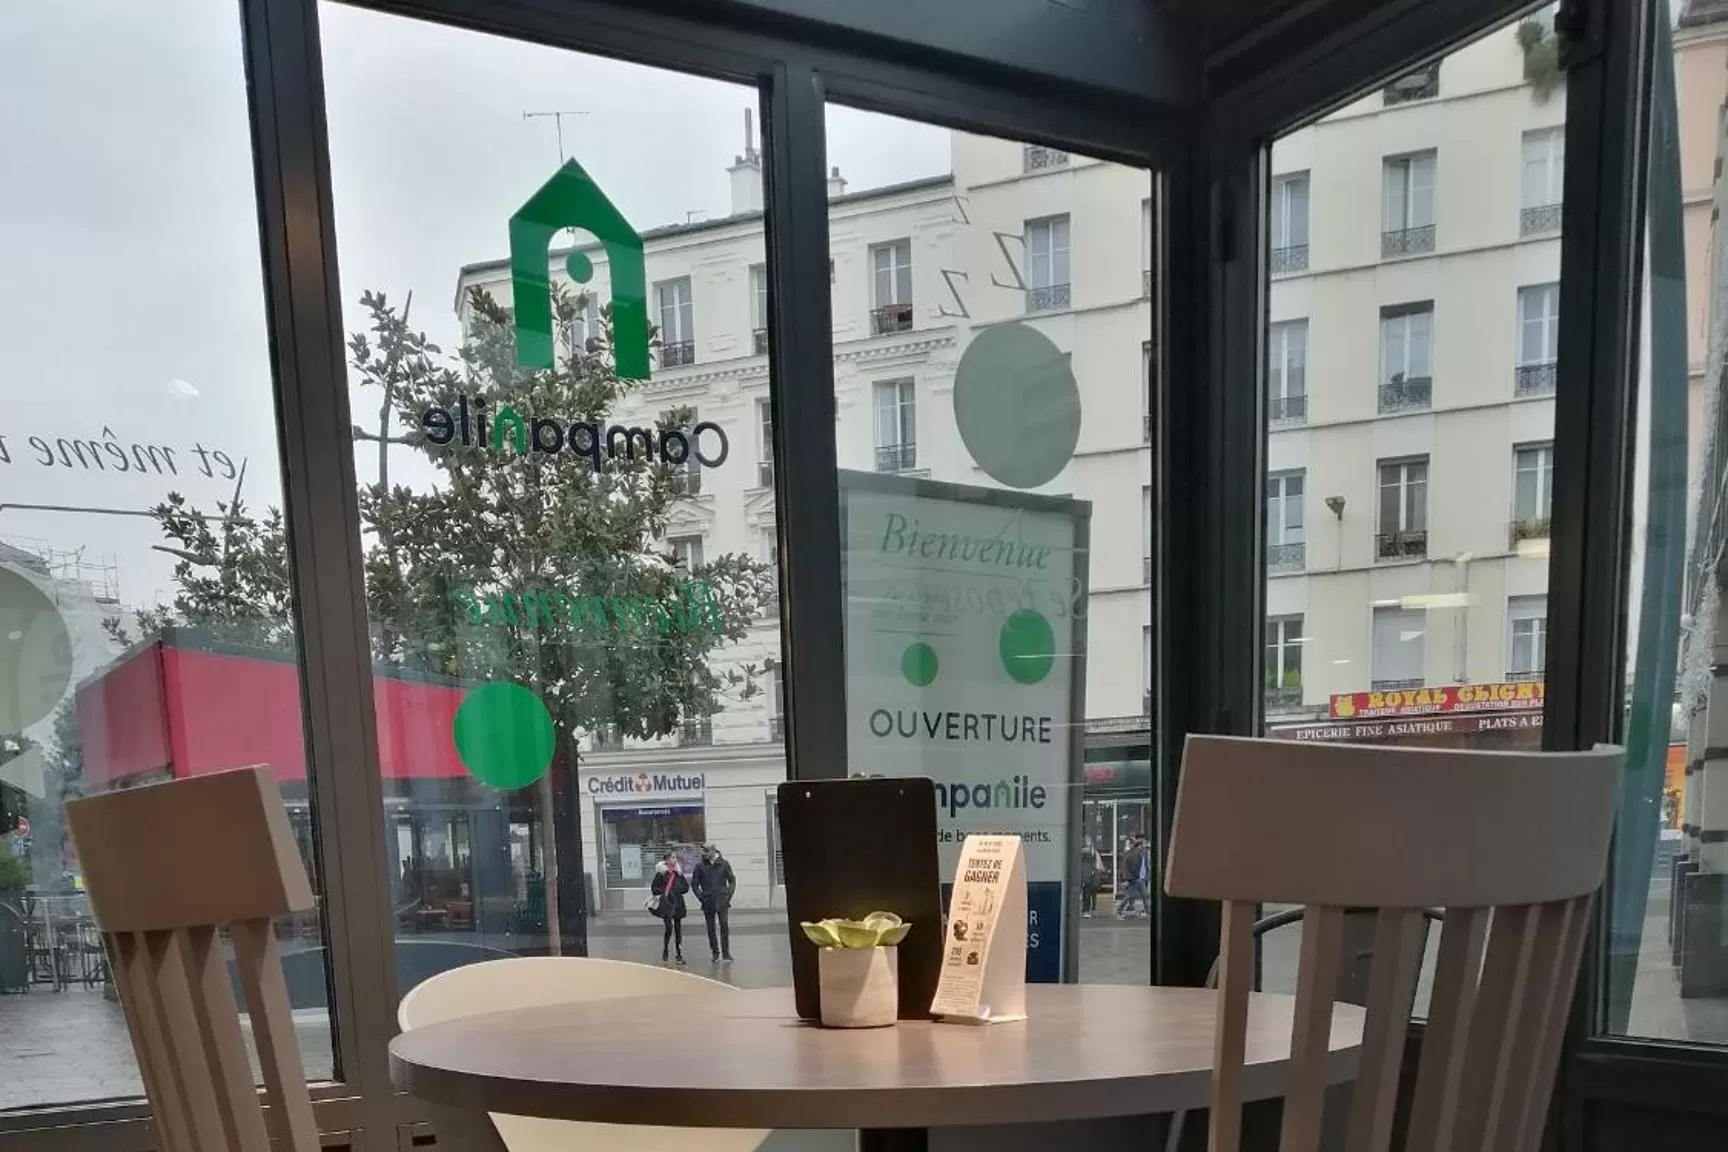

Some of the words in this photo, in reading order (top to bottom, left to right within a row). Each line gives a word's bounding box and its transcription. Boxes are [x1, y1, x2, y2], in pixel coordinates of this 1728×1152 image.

[879, 512, 1053, 570] Bienvenue
[1367, 689, 1448, 708] ROYAL
[870, 709, 1051, 742] OUVERTURE
[1296, 726, 1350, 740] EPICERIE
[1355, 725, 1384, 737] FINE
[1388, 721, 1451, 735] ASIATIQUE
[1479, 716, 1516, 729] PLATS
[588, 777, 634, 793] Crédit
[653, 774, 705, 791] Mutuel
